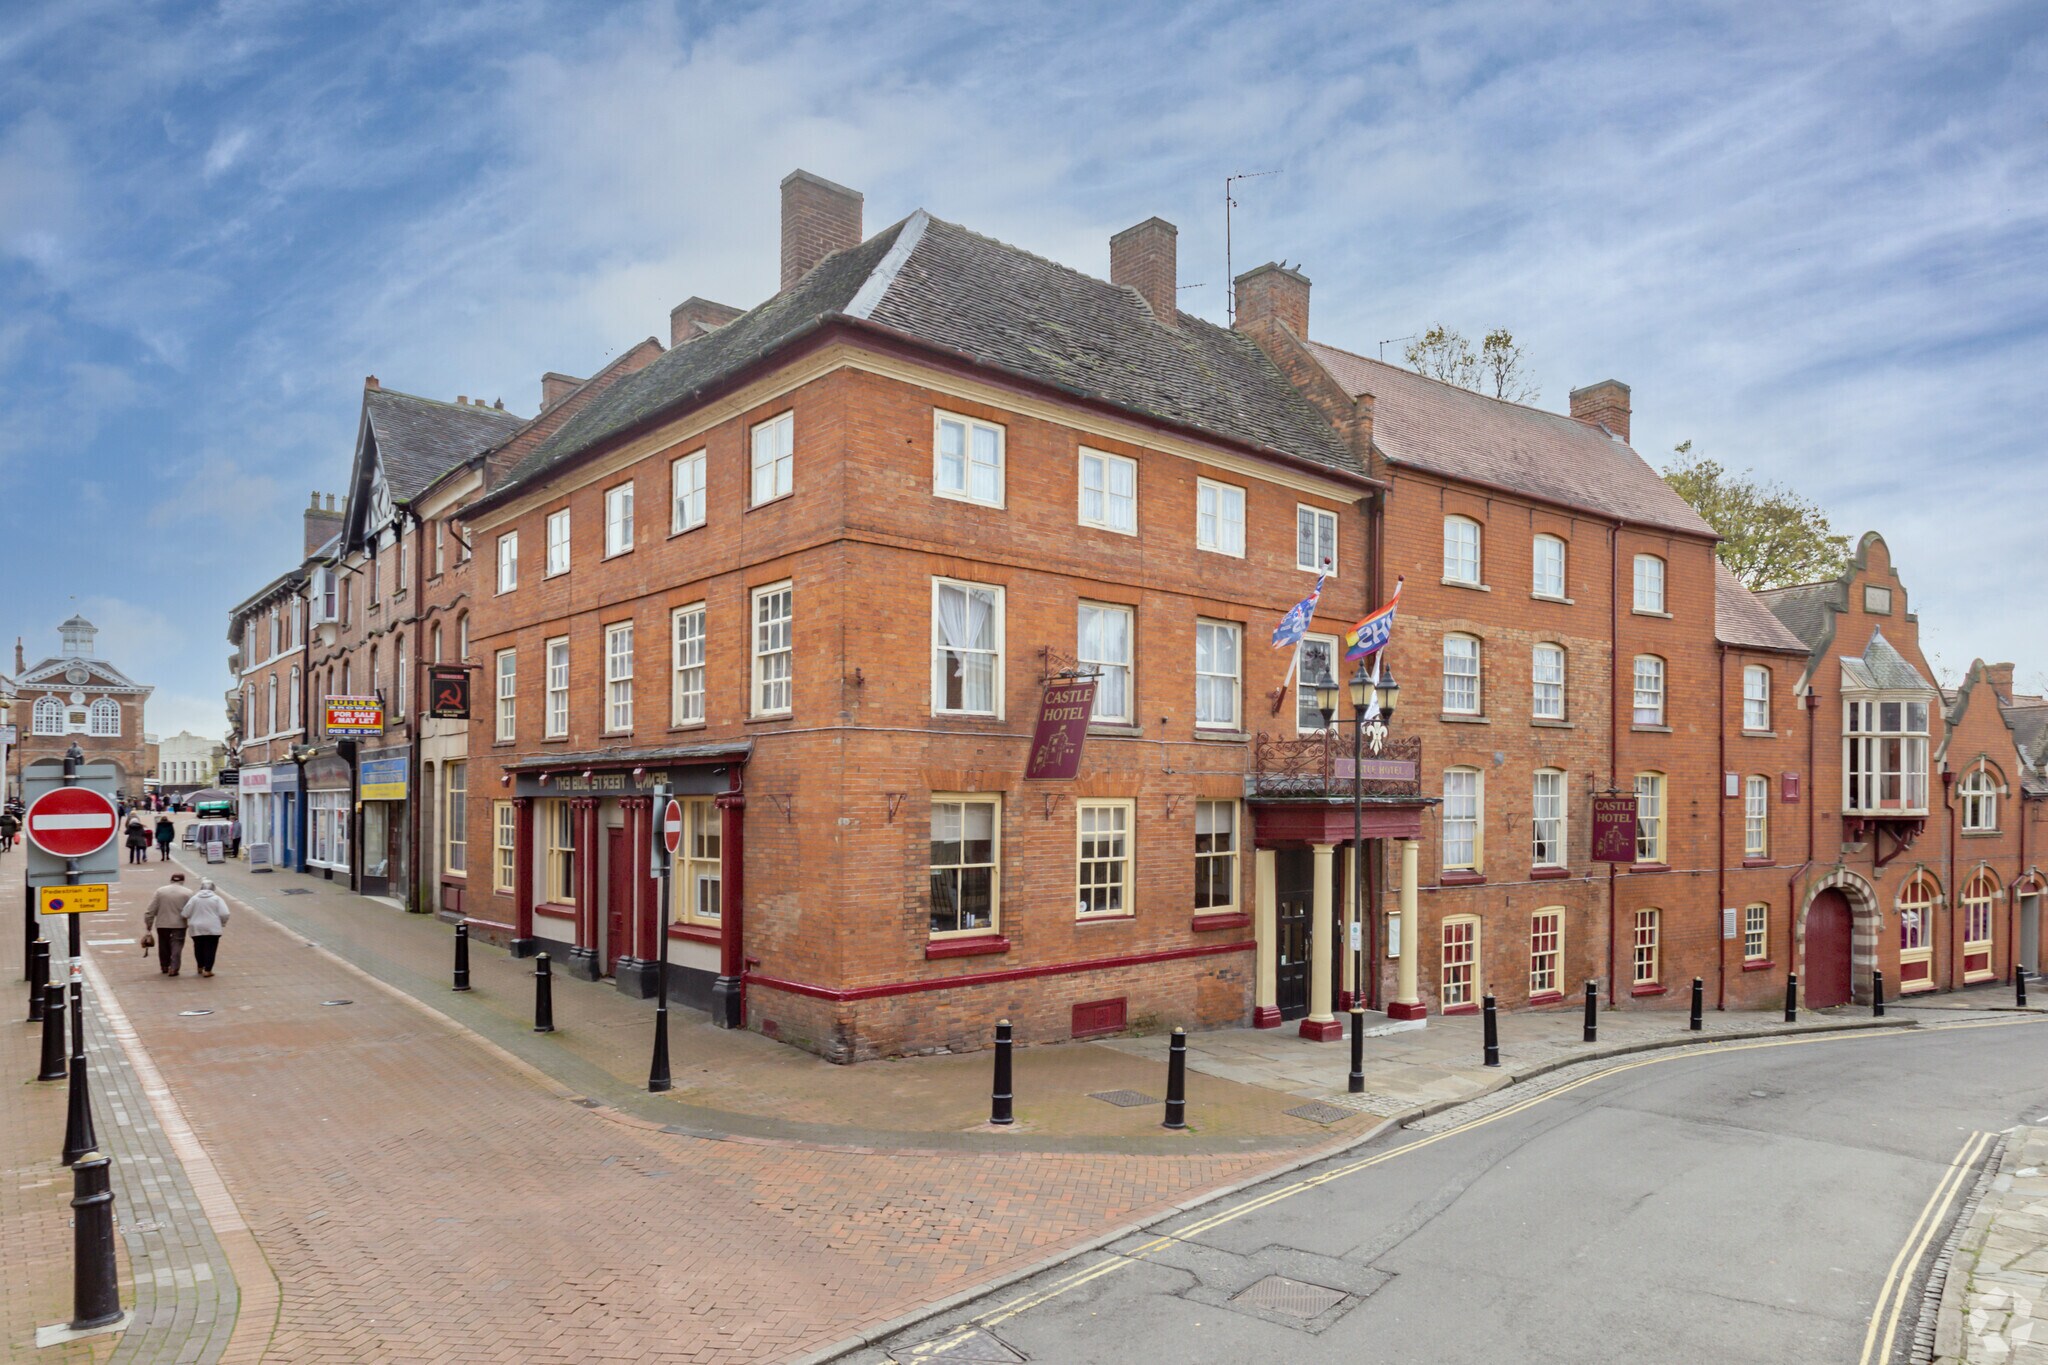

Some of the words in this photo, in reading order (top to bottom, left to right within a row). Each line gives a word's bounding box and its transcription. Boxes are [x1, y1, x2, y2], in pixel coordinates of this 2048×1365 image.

[1045, 689, 1093, 704] CASTLE
[1043, 707, 1085, 721] HOTEL
[1379, 765, 1405, 775] HOTEL
[1595, 801, 1635, 811] CASTLE
[1597, 813, 1632, 823] HOTEL
